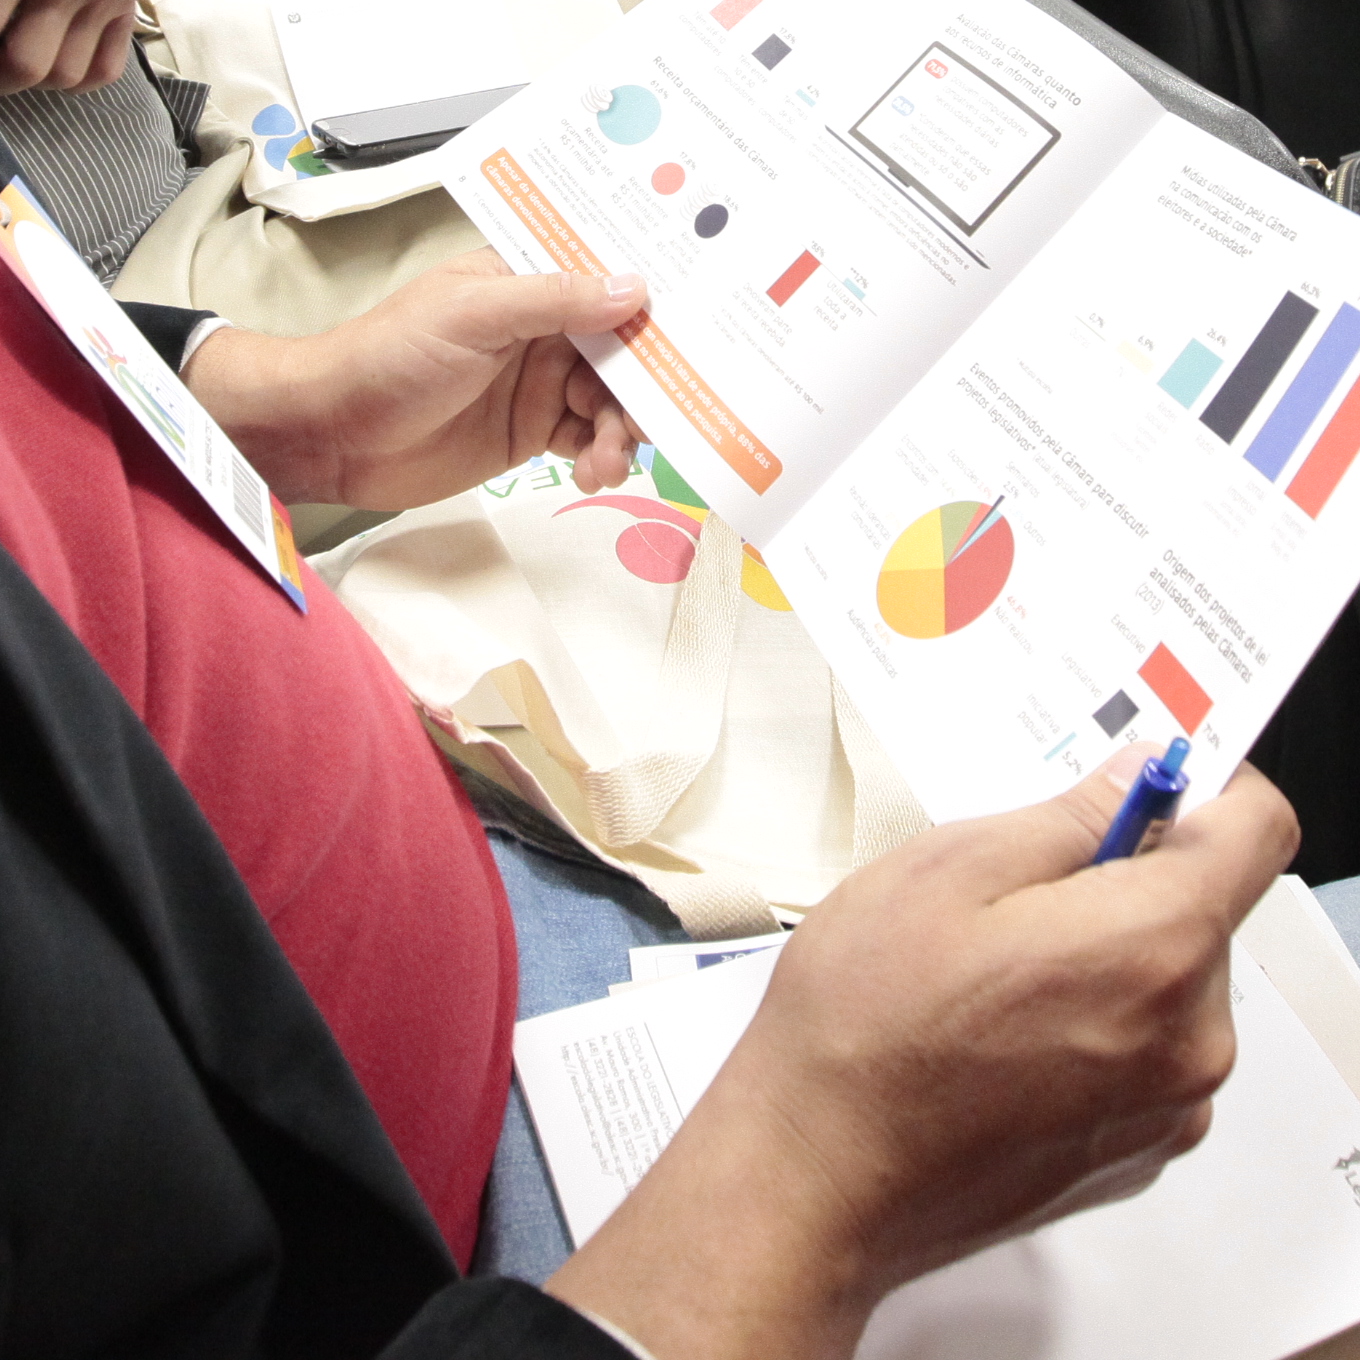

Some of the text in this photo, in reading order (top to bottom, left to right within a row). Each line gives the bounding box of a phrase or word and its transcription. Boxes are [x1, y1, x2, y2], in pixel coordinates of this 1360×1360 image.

[989, 36, 1008, 52] das
[1005, 44, 1046, 79] Câmaras
[1042, 73, 1083, 108] quanto
[1002, 64, 1059, 111] informática
[650, 54, 686, 89] Receita
[680, 86, 737, 141] orçamentária
[732, 136, 750, 154] das
[746, 148, 780, 182] Câmaras
[484, 163, 576, 271] câmaras devolveram receitas
[496, 155, 523, 184] Apesar
[525, 190, 571, 243] identificação
[1156, 193, 1195, 224] eleitores
[1178, 186, 1234, 227] comunicação
[1230, 219, 1252, 237] com
[1180, 163, 1299, 243] Mídias utilizadas pela Câmara
[640, 325, 657, 343] com
[650, 338, 675, 364] relação
[673, 363, 692, 382] falta
[694, 386, 715, 408] sede
[707, 403, 742, 439] própria,
[736, 432, 758, 454] 88%
[752, 449, 773, 470] das
[644, 353, 660, 369] ano
[653, 364, 681, 393] anterior
[689, 406, 727, 446] pesquisa.
[801, 390, 815, 405] 100
[955, 375, 991, 411] projetos
[968, 361, 1002, 396] Eventos
[995, 390, 1046, 439] promovidos
[1039, 433, 1064, 457] pela
[1059, 449, 1097, 487] Câmara
[1090, 482, 1116, 508] para
[1110, 501, 1152, 540] discutir
[1147, 566, 1257, 685] analisados pelas Câmaras
[1160, 547, 1198, 588] Origem
[1192, 581, 1215, 605] dos
[1206, 598, 1249, 643] projetos
[623, 1025, 647, 1065] ESCOLA
